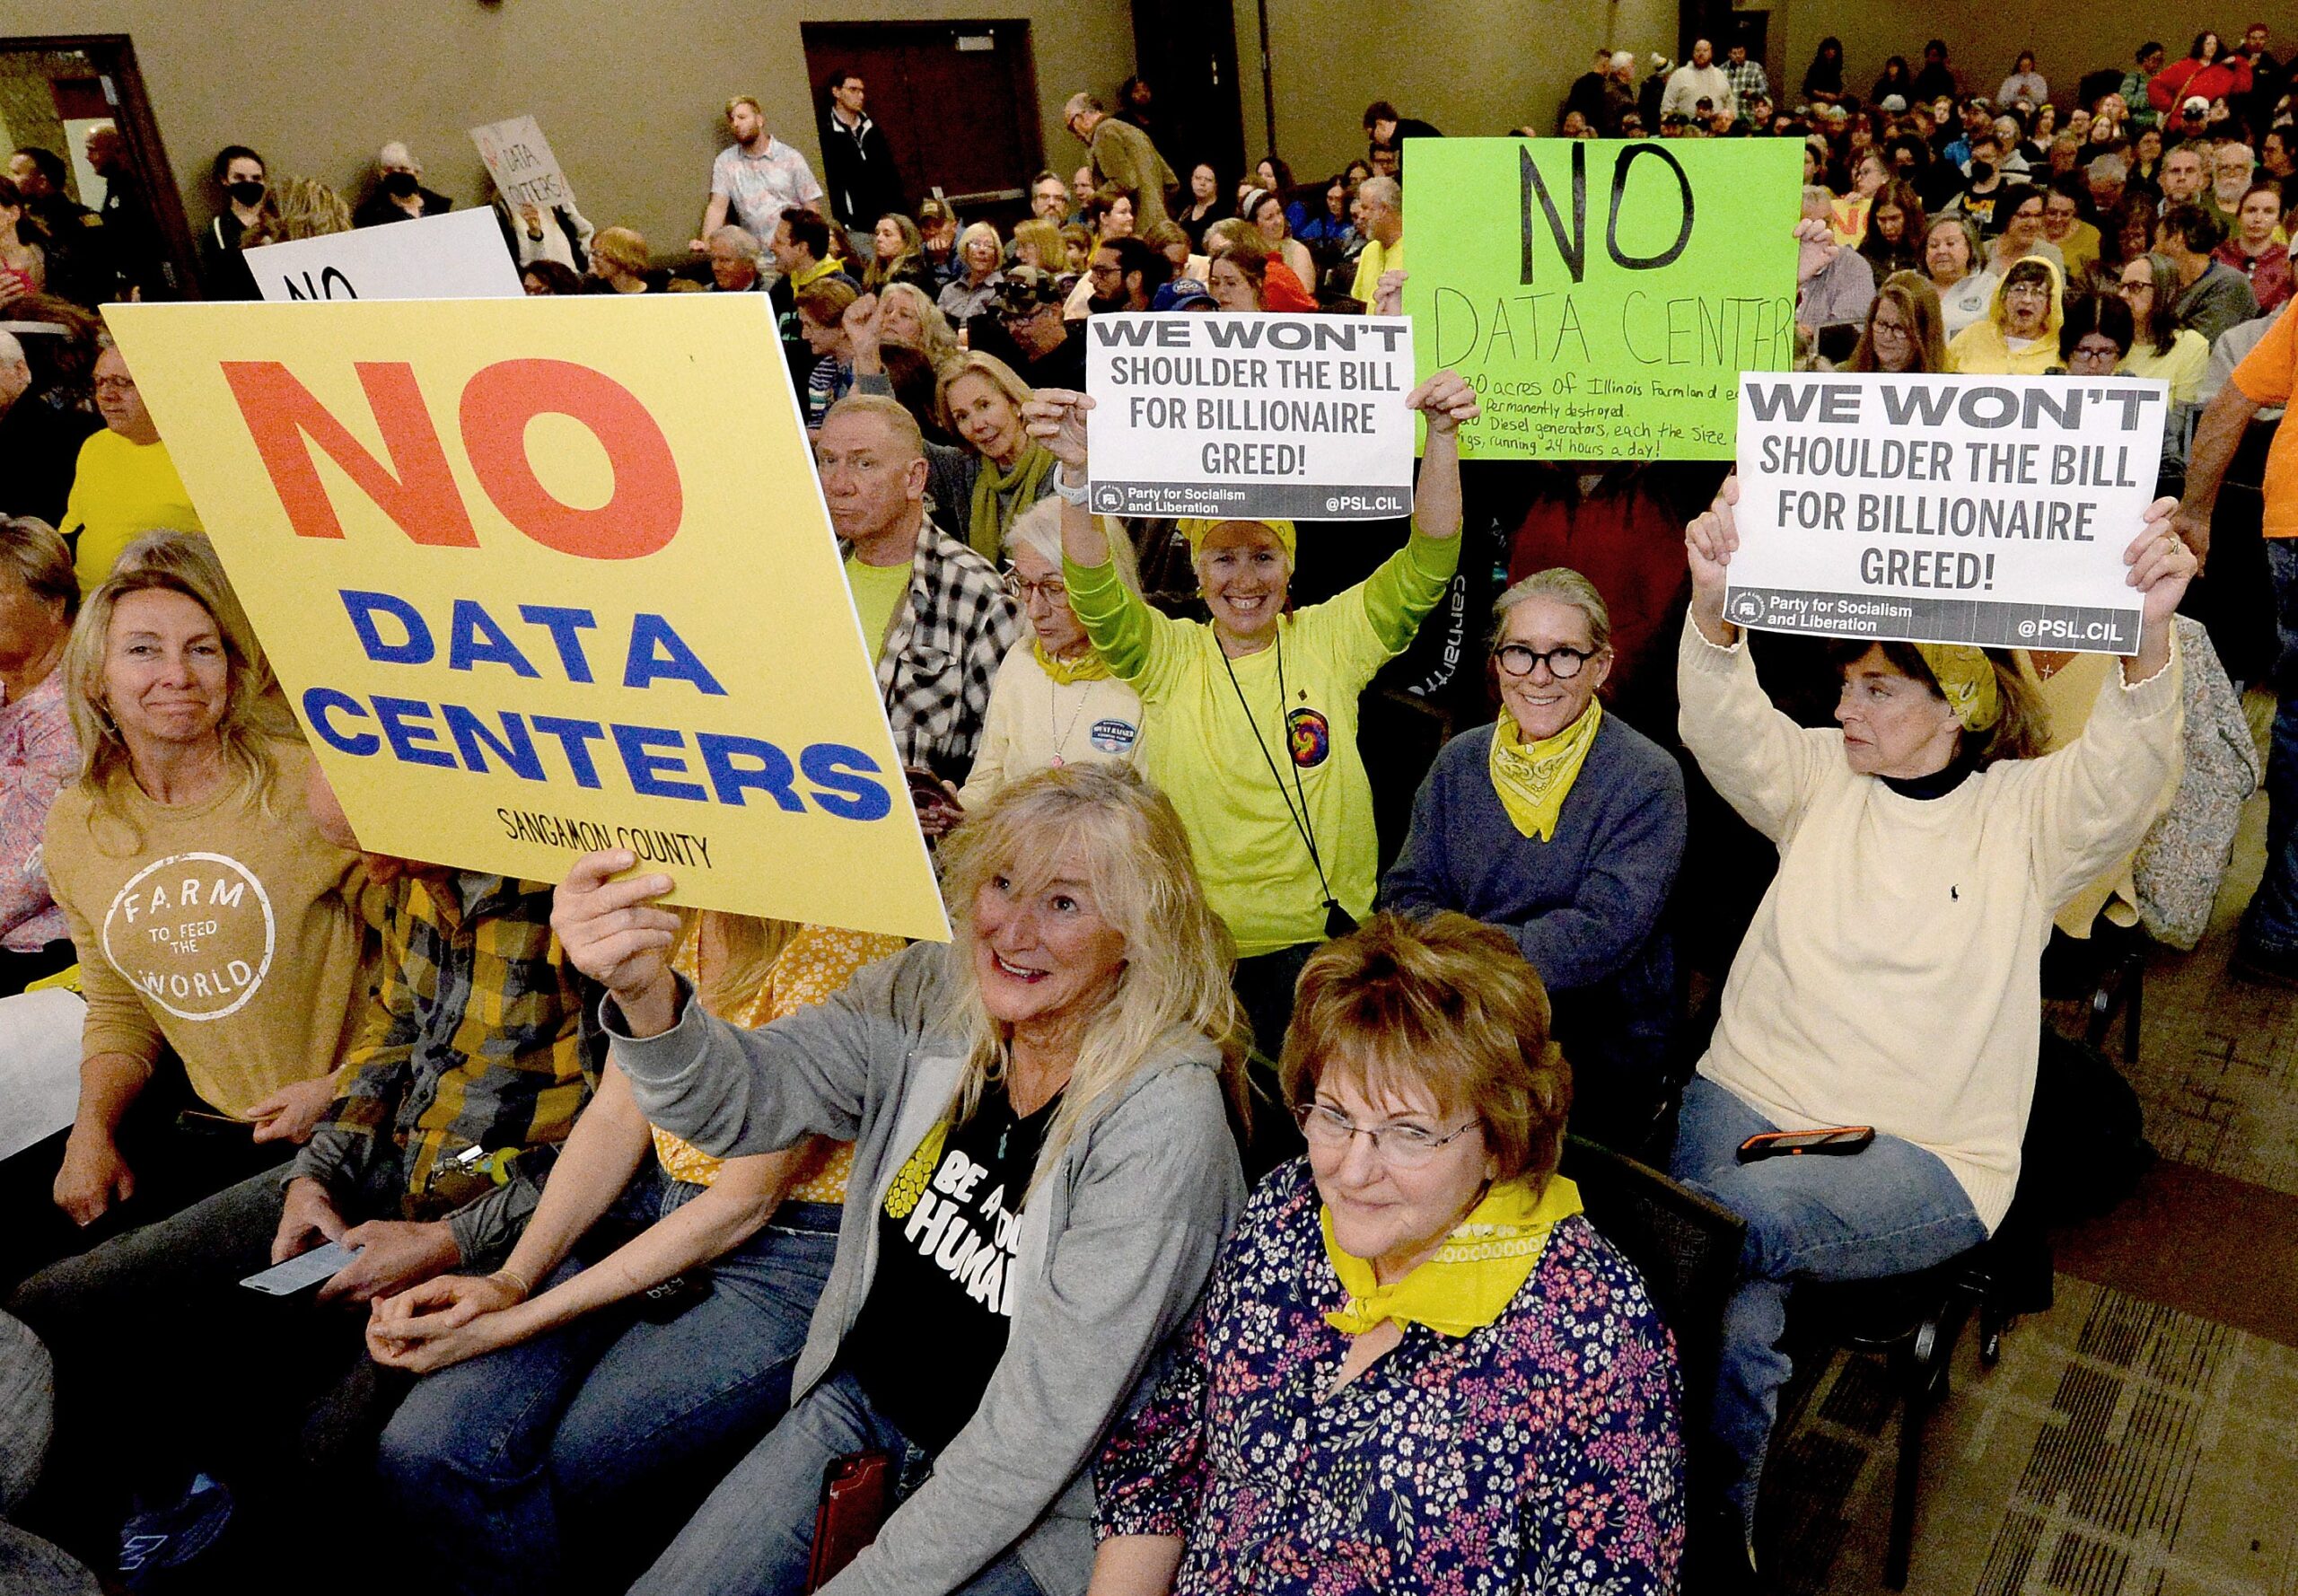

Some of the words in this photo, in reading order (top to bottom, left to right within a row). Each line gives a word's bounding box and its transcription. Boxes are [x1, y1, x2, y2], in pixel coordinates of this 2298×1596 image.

[1520, 141, 1695, 285] NO
[1831, 207, 1870, 235] N
[1093, 320, 1191, 347] WE
[1204, 320, 1407, 352] WON'T
[1435, 287, 1591, 368] DATA
[1110, 356, 1267, 388] SHOULDER
[1276, 360, 1331, 390] THE
[1340, 361, 1400, 391] BILL
[1494, 381, 1542, 396] acres
[1587, 377, 1643, 396] Illinois
[1130, 397, 1187, 429] FOR
[1197, 399, 1375, 434] BILLIONAIRE
[1745, 383, 1862, 423] WE
[1881, 385, 2160, 430] WON'T
[1490, 416, 1530, 433] Diesel
[1615, 422, 1651, 438] each
[1657, 421, 1685, 439] the
[218, 357, 684, 561] NO
[1202, 443, 1305, 476] GREED!
[1489, 436, 1537, 456] running
[1544, 438, 1564, 453] 24
[1569, 439, 1604, 456] hours
[1611, 447, 1623, 456] a
[1627, 440, 1661, 458] day!
[1759, 434, 1953, 481] SHOULDER
[1965, 442, 2040, 484] THE
[2049, 444, 2136, 487] BILL
[1127, 487, 1161, 501] Party
[1163, 488, 1181, 499] for
[1184, 488, 1246, 501] Socialism
[1128, 502, 1153, 512] and
[1155, 502, 1219, 513] Liberation
[1326, 496, 1402, 512] @PSL.CIL
[1778, 489, 1846, 531] FOR
[1856, 493, 2097, 541] BILLIONAIRE
[1860, 547, 1995, 591] GREED!
[1767, 614, 1795, 627] and
[1800, 614, 1877, 632] Liberation
[1770, 595, 1808, 613] Party
[1812, 598, 1834, 612] for
[1838, 601, 1912, 618] Socialism
[338, 588, 730, 697] DATA
[2018, 619, 2123, 643] @PSL.CIL
[302, 686, 893, 822] CENTERS
[496, 808, 612, 852] SANGAMON
[617, 827, 712, 869] COUNTY
[124, 879, 244, 923] FARM
[149, 927, 170, 942] TO
[180, 920, 217, 938] FEED
[170, 940, 198, 953] THE
[137, 960, 251, 998] WORLD
[933, 1150, 988, 1203] BE
[979, 1184, 1004, 1221] A
